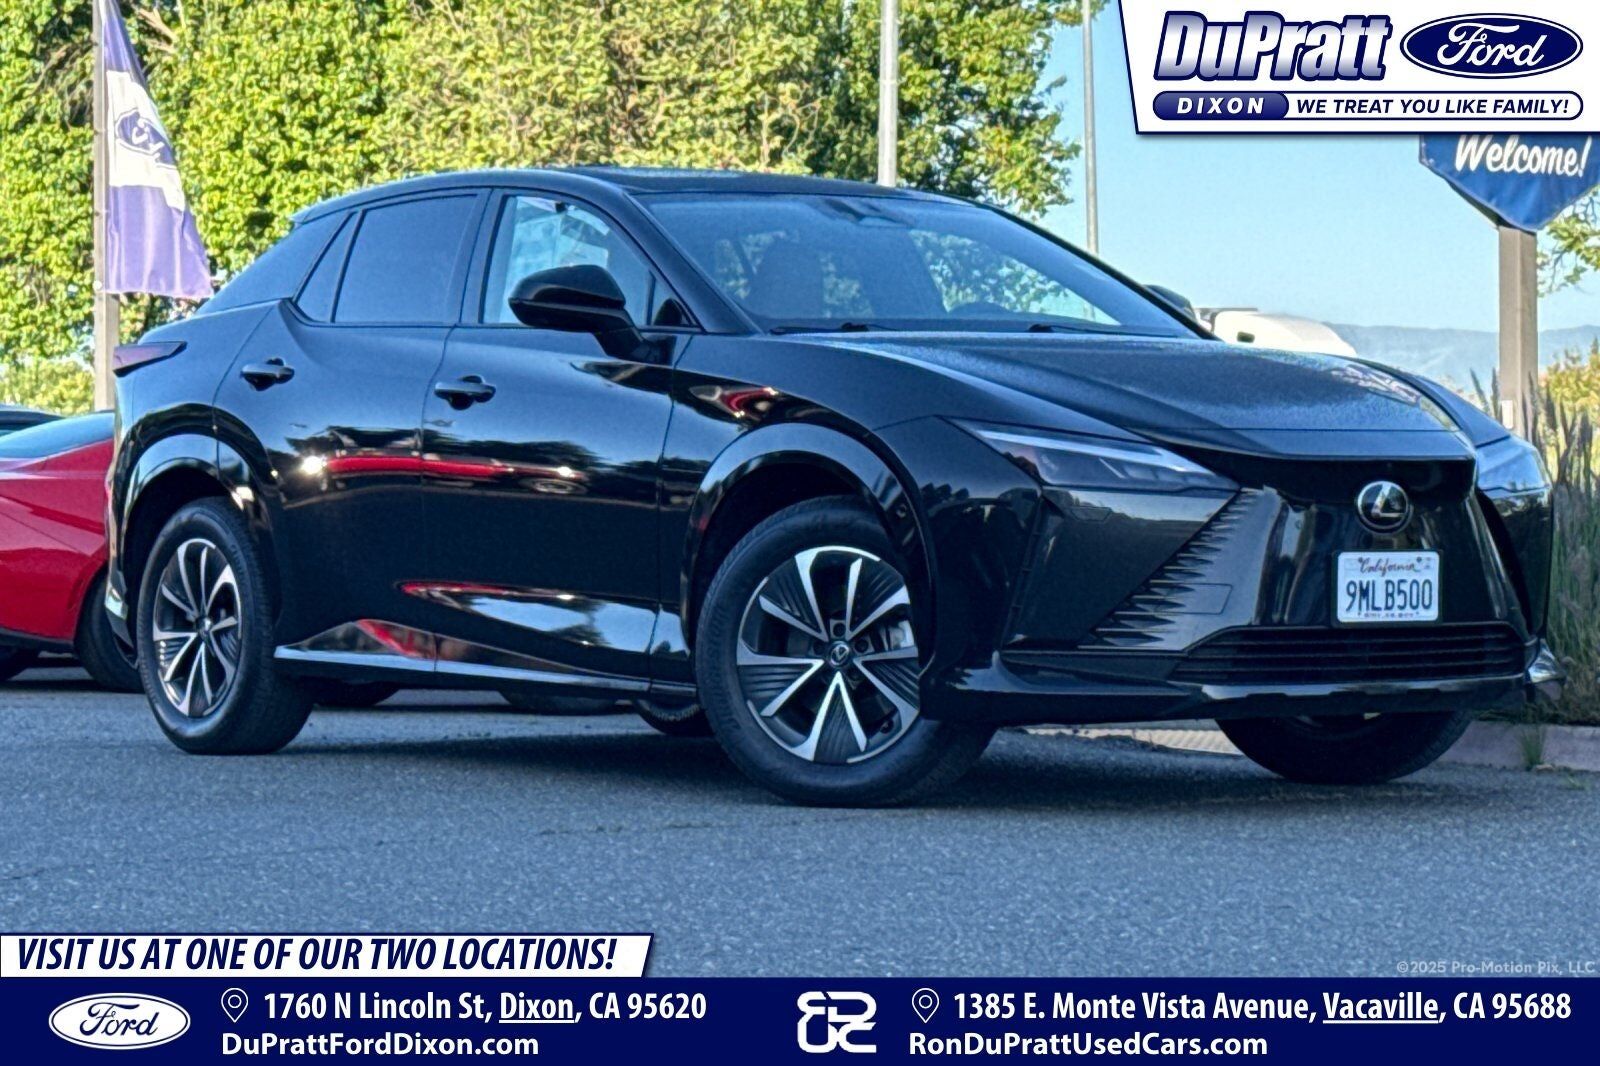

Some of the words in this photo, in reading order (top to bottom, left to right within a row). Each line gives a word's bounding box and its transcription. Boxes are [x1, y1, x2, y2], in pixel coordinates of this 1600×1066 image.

[1455, 134, 1590, 178] Welcome!
[1360, 557, 1420, 577] California
[1346, 579, 1433, 612] 9MLB500
